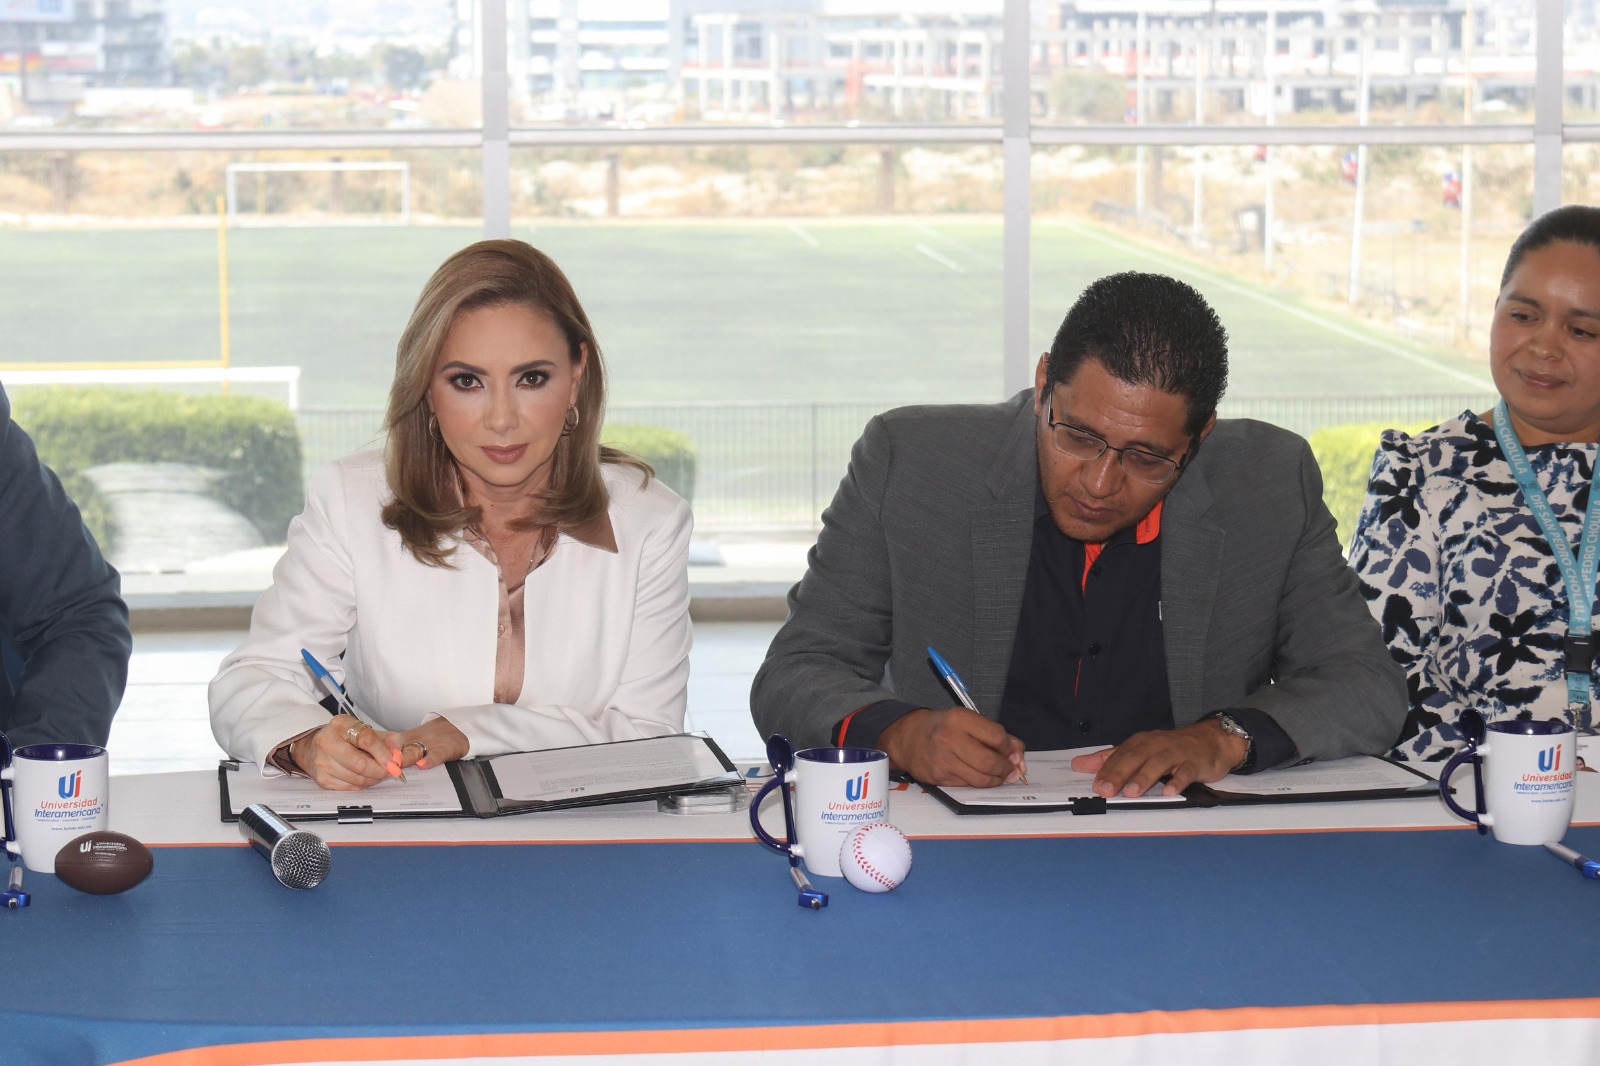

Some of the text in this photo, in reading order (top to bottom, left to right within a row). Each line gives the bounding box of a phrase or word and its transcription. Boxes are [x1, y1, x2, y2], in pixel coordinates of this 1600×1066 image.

[1499, 426, 1528, 475] CHOLULA
[1530, 494, 1546, 511] DIF
[1538, 511, 1556, 531] SAN
[1549, 531, 1572, 566] PEDRO
[1581, 545, 1596, 582] PEDRO
[1521, 771, 1573, 782] Universidad
[40, 796, 98, 810] Universidad
[828, 799, 883, 811] Universidad
[34, 807, 101, 819] Interamericana
[820, 810, 885, 821] Interamericana
